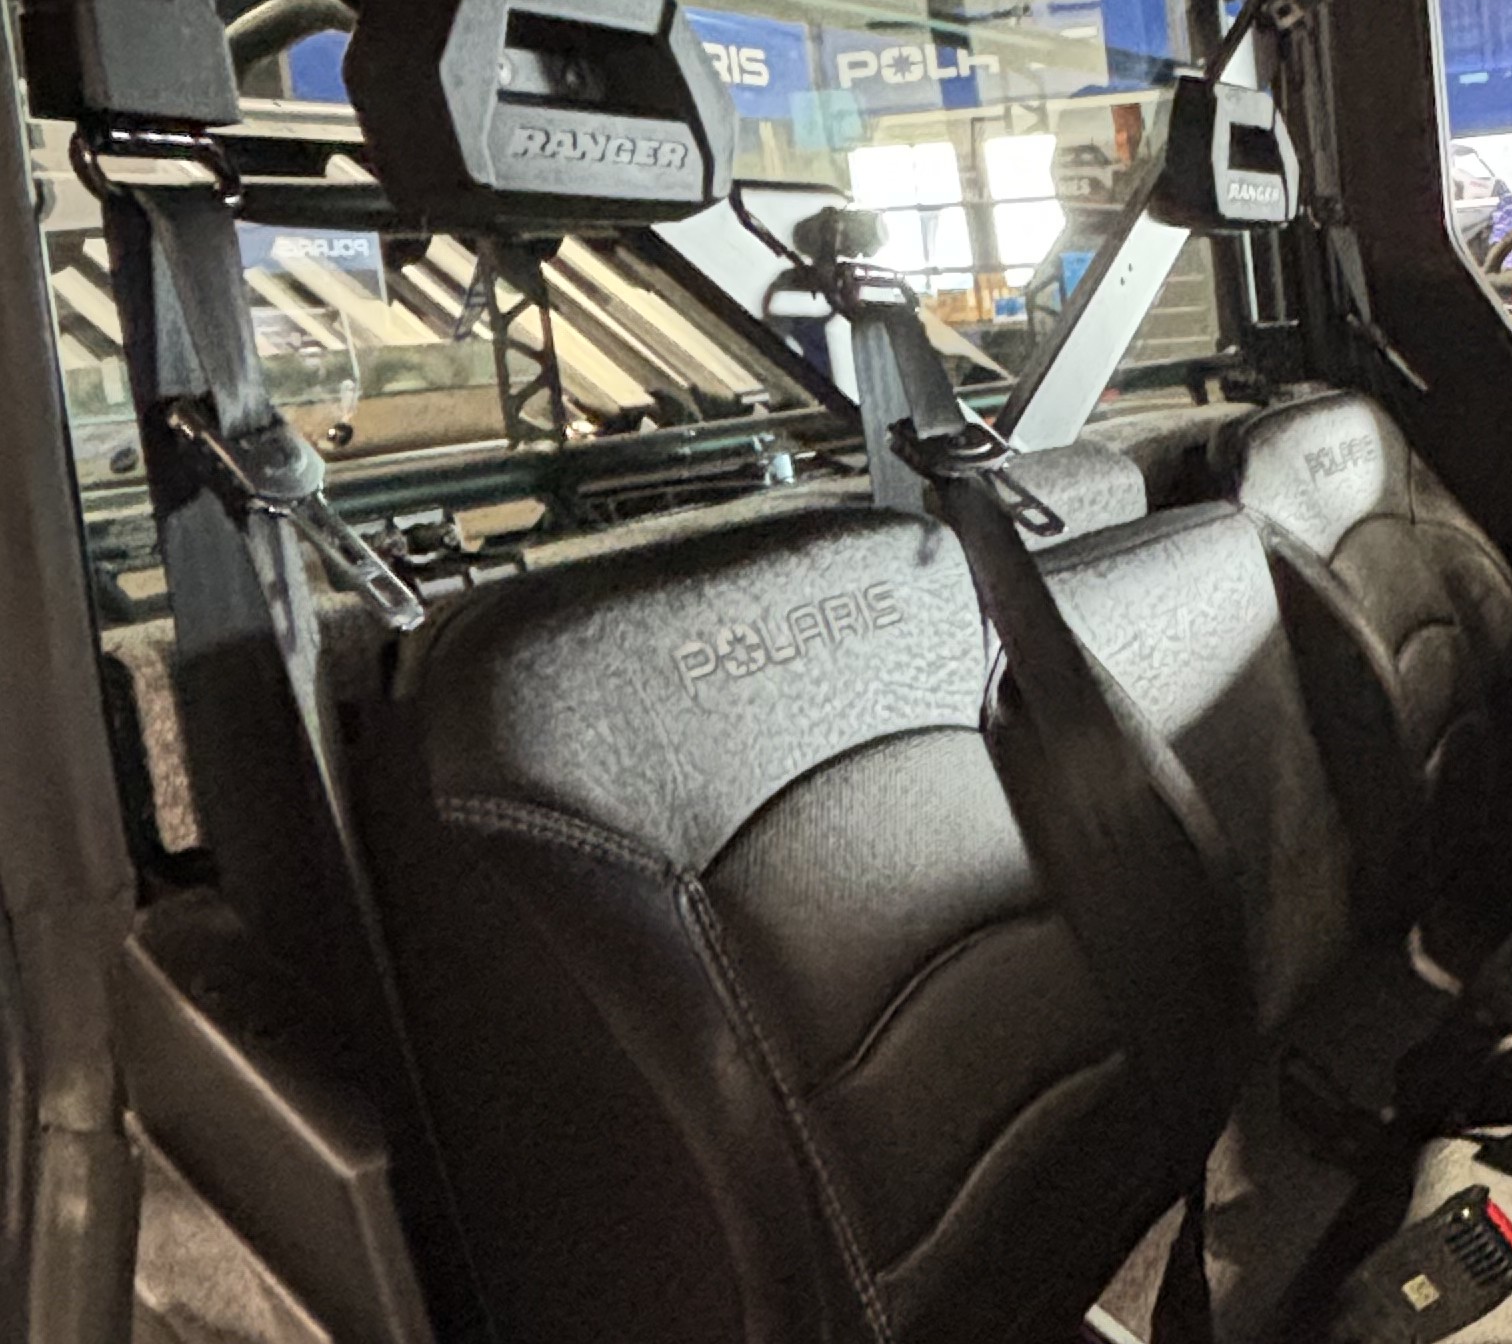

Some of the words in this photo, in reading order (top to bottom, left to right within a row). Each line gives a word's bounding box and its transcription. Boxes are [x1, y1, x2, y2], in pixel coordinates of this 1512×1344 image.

[510, 127, 688, 168] RANGER
[1227, 181, 1280, 203] RANGER
[673, 581, 902, 699] POLARIS
